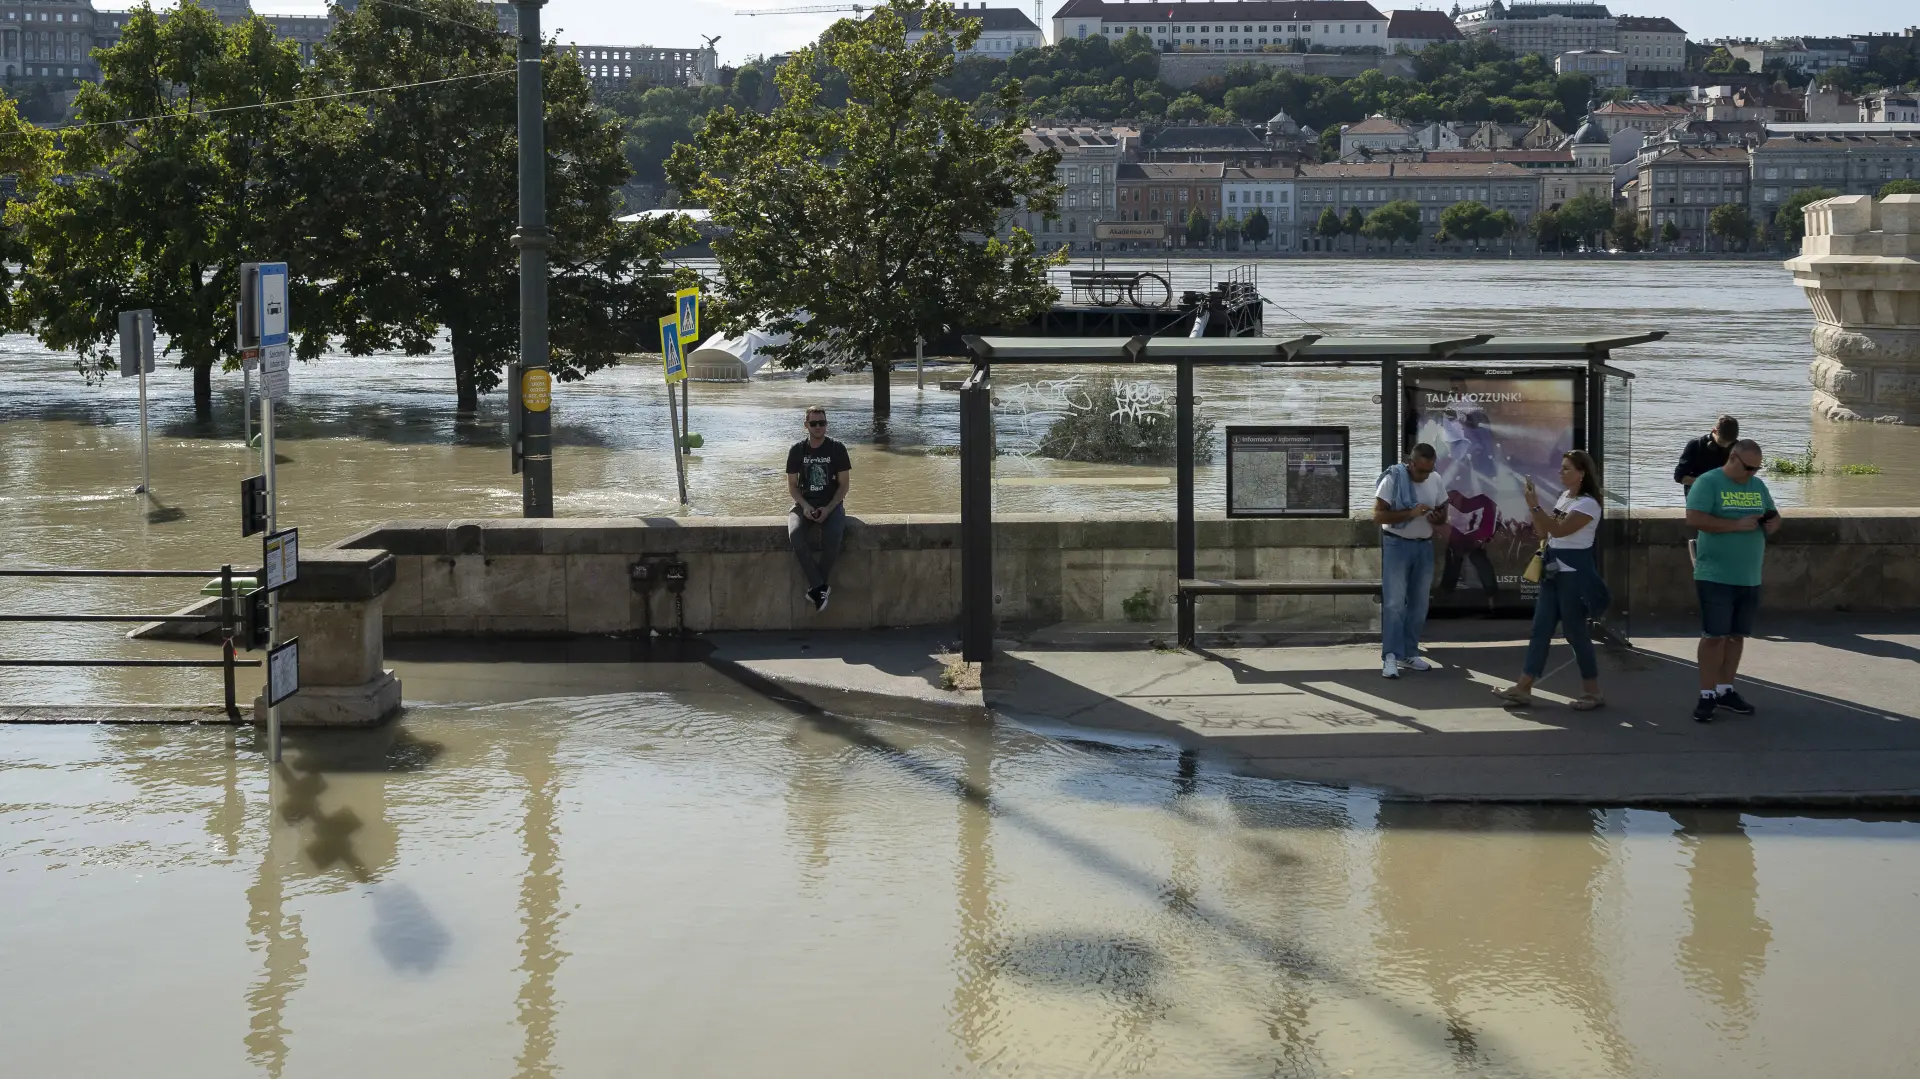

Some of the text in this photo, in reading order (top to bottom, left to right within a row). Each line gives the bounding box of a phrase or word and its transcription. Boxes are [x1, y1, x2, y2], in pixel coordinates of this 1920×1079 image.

[1426, 390, 1522, 403] TALÁLKOZZUNK!
[1721, 492, 1762, 500] UNDER
[1496, 575, 1518, 583] LISZT
